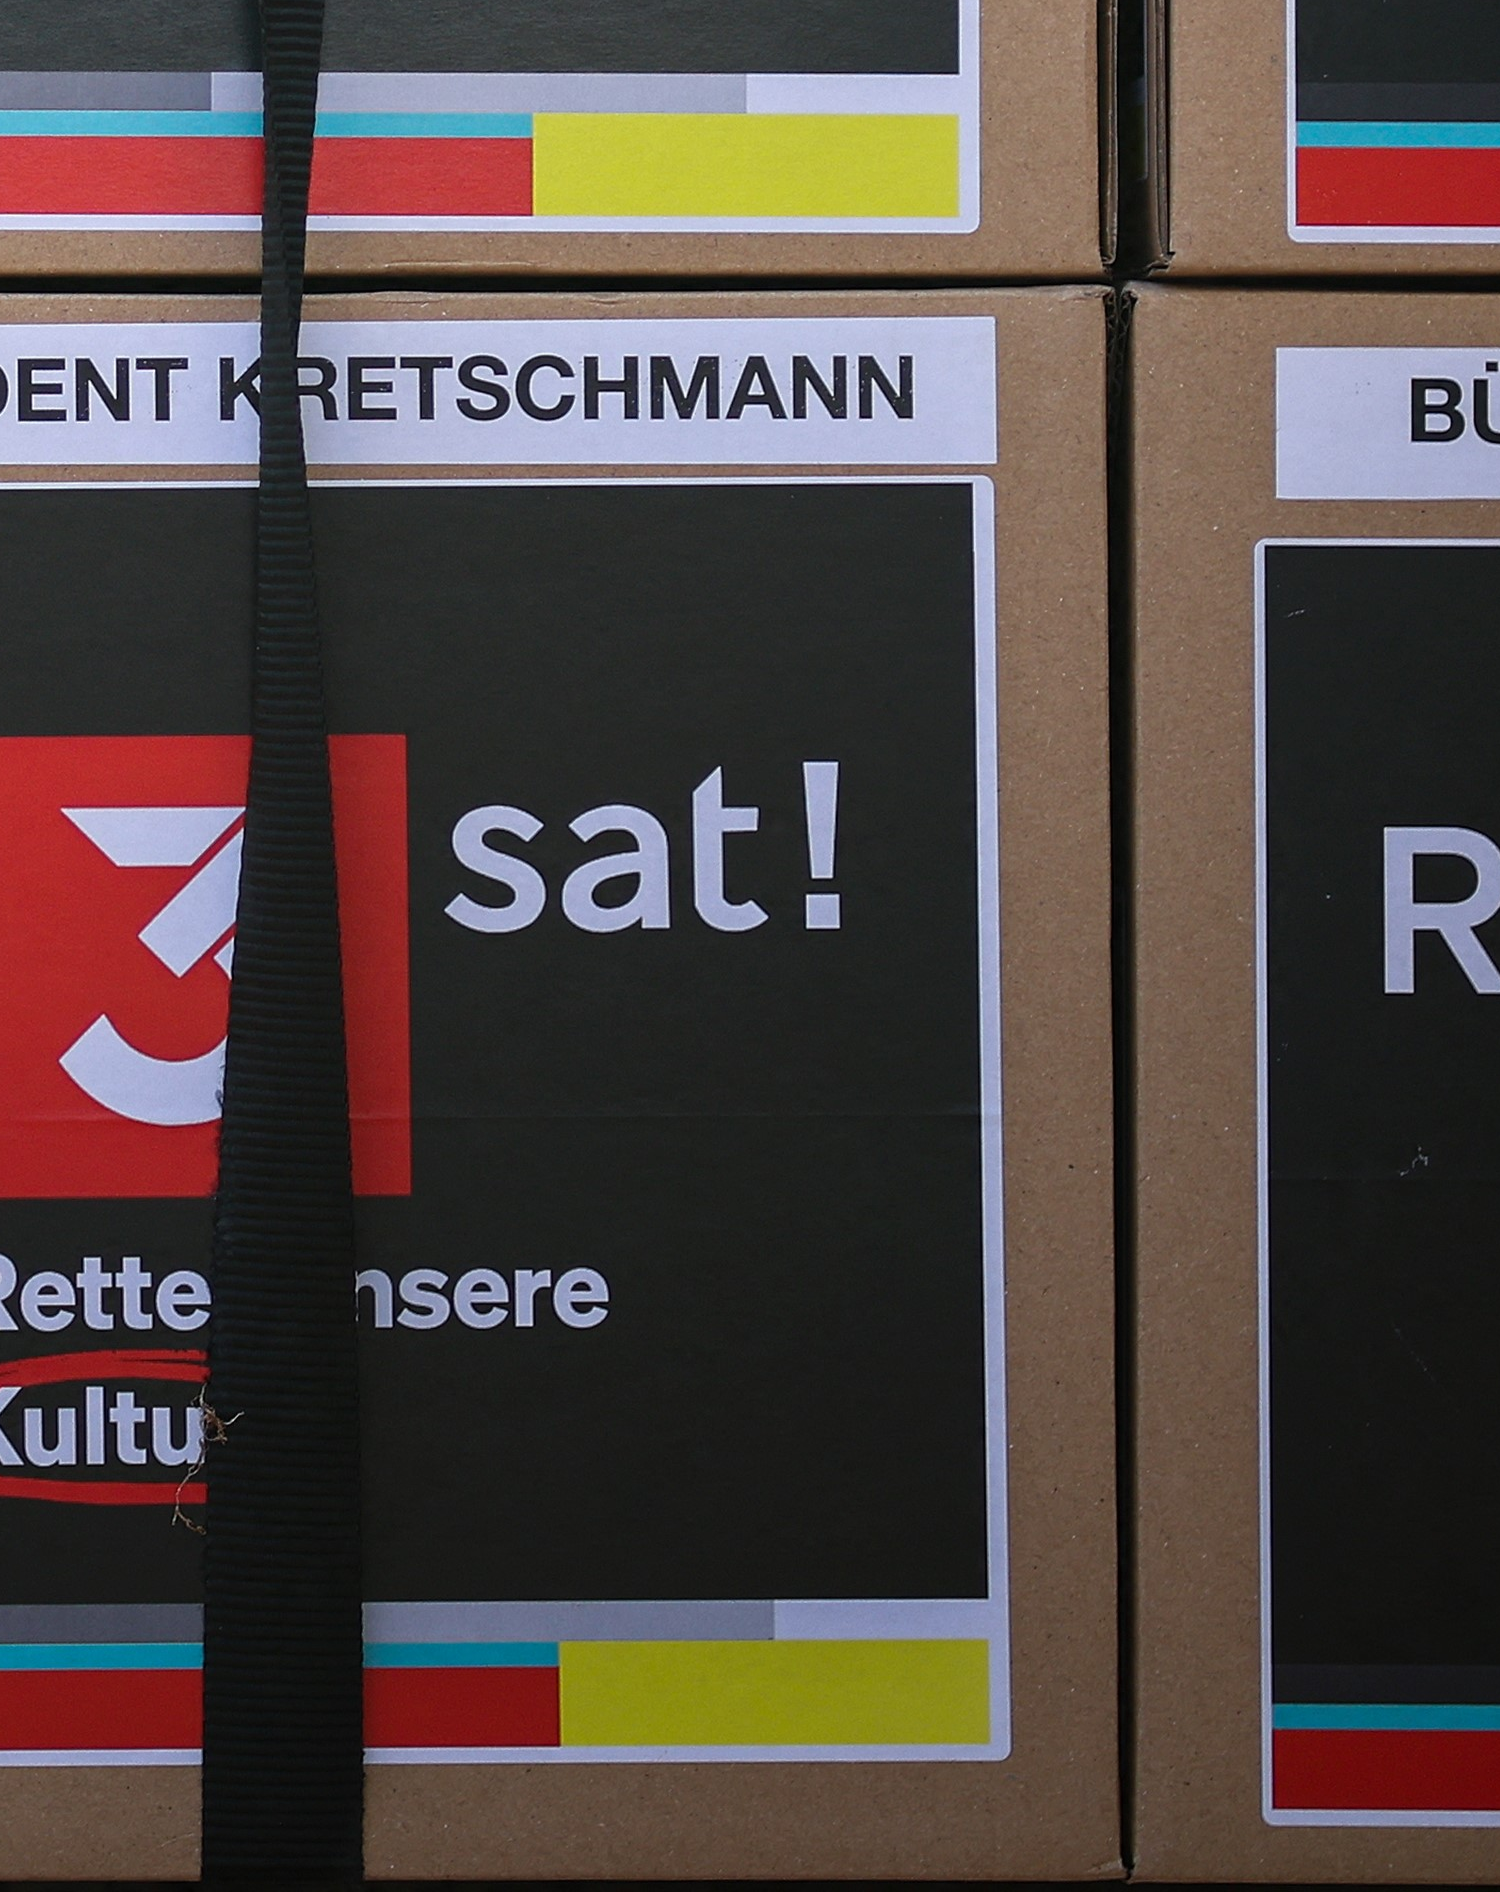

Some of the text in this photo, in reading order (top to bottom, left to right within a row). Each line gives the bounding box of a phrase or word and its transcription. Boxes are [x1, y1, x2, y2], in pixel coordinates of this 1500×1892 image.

[57, 805, 248, 1127] 3
[443, 760, 842, 934] sat!
[355, 1266, 610, 1331] nsere
